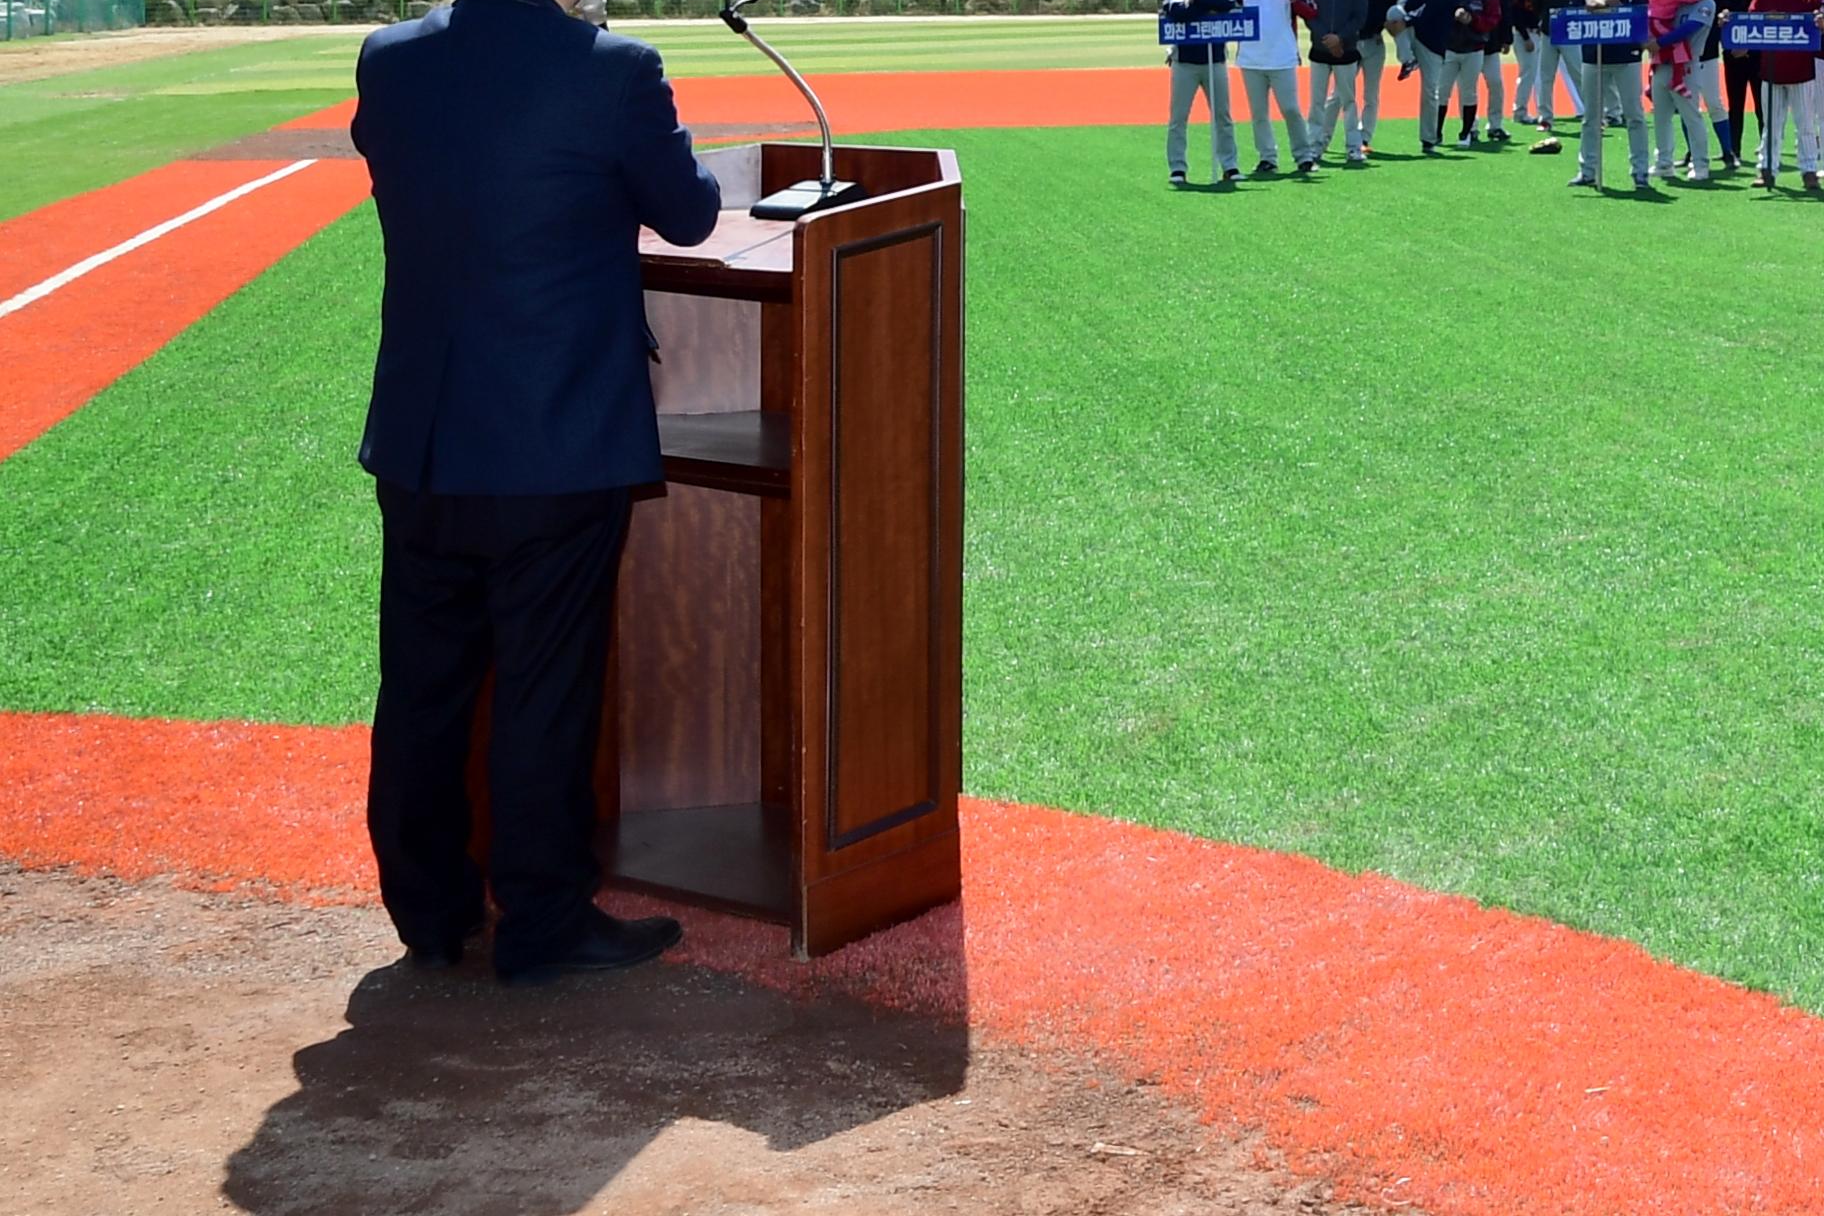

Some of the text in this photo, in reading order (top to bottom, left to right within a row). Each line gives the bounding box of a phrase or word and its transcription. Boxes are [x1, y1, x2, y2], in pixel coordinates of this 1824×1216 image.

[1164, 19, 1254, 40] 화천 그린베이스볼
[1566, 19, 1632, 40] 칠까말까
[1731, 25, 1810, 44] 애스트로스
